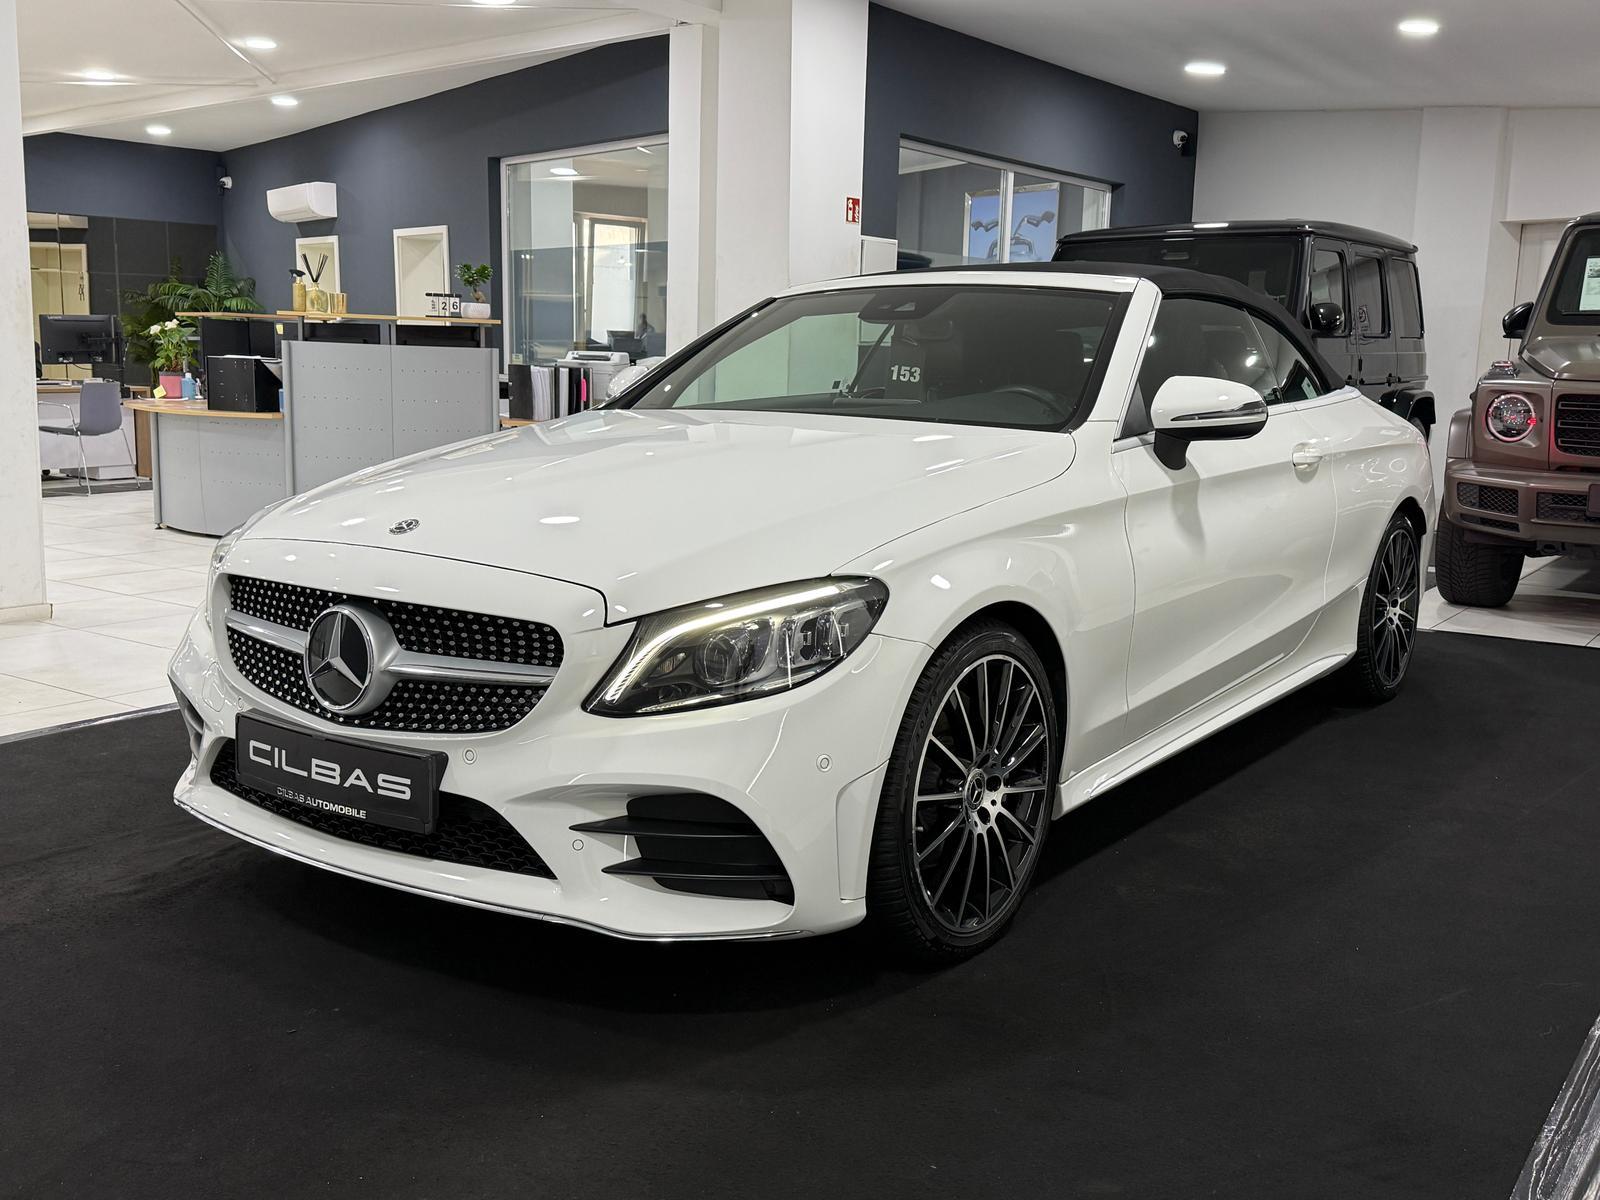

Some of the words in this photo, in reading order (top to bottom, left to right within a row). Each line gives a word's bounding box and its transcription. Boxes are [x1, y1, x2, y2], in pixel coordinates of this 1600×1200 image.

[890, 364, 921, 383] 153
[249, 739, 412, 800] CILBAS
[276, 786, 305, 803] CILBAS
[305, 796, 367, 819] AUTOMOBILE
